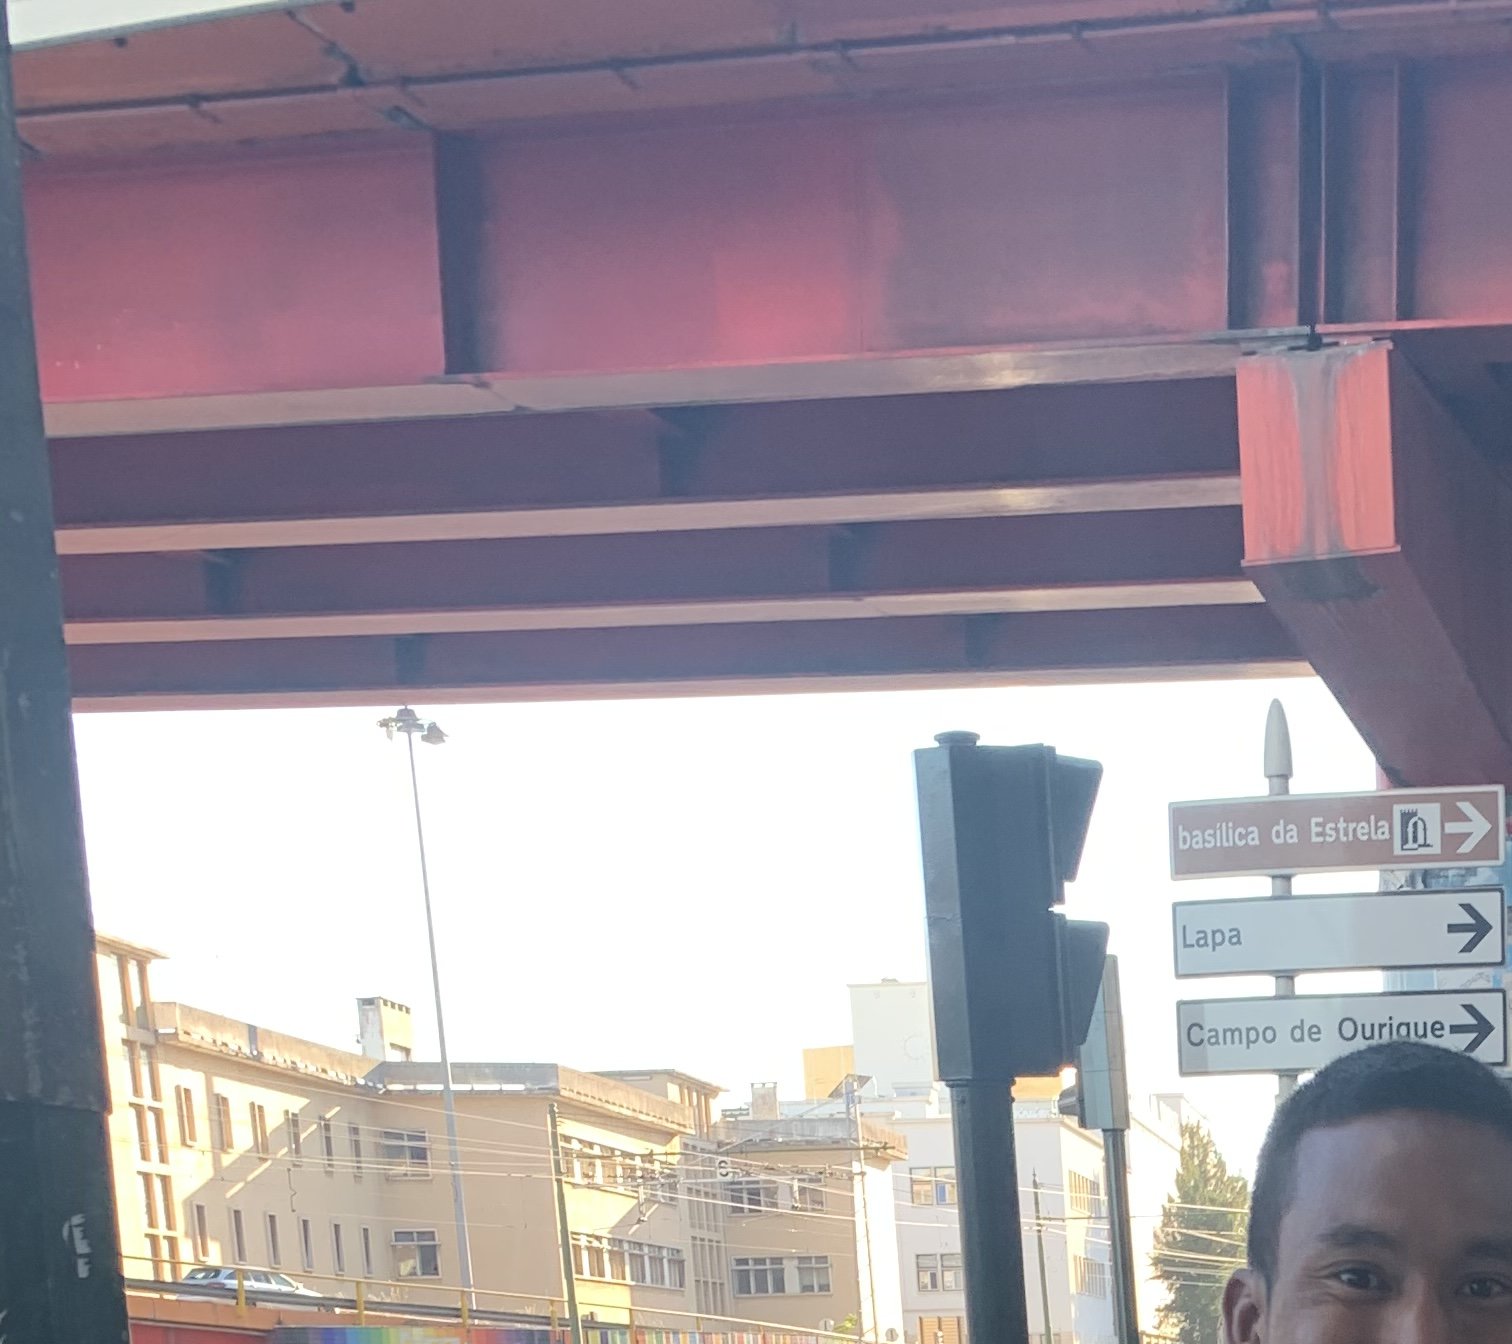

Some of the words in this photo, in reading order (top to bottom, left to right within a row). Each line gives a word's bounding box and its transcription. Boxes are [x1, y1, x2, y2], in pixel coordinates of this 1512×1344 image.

[1178, 821, 1260, 850] basílica
[1271, 819, 1298, 845] da
[1310, 814, 1391, 843] Estrela
[1182, 925, 1243, 952] Lapa
[1187, 1022, 1277, 1049] Campo
[1290, 1018, 1322, 1043] de
[1338, 1015, 1445, 1044] Ourique
